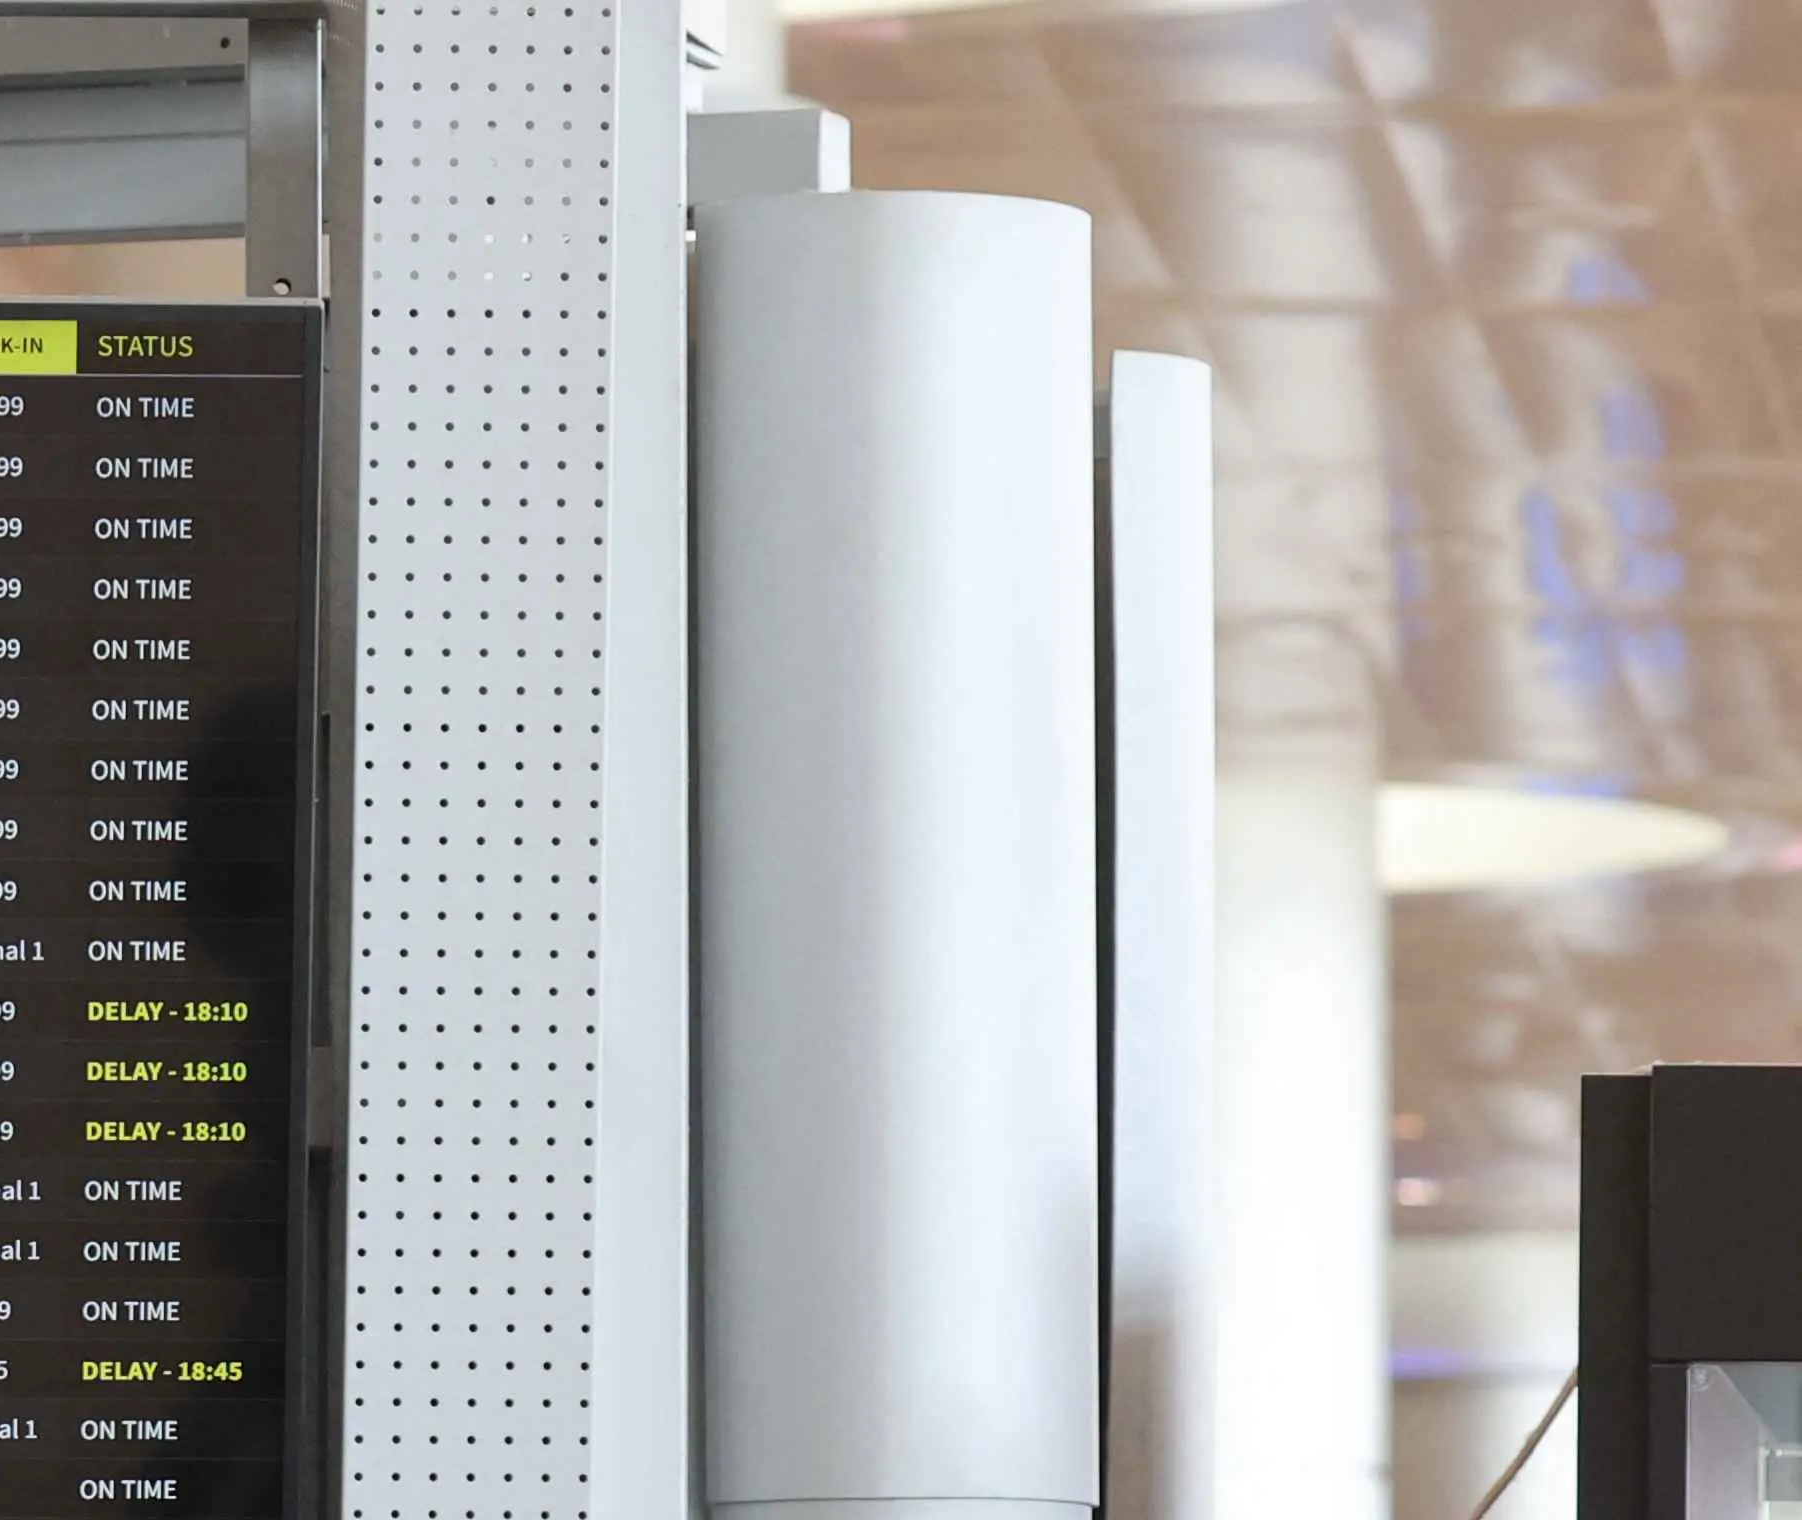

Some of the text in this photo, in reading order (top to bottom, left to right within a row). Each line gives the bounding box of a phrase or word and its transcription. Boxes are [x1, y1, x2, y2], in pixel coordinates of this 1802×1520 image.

[98, 335, 193, 357] STATUS
[96, 396, 131, 418] ON
[138, 397, 195, 418] TIME
[94, 518, 129, 540] ON
[136, 518, 193, 539] TIME
[91, 759, 126, 781] ON
[132, 760, 189, 781] TIME
[32, 941, 45, 961] 1
[88, 940, 123, 962] ON
[129, 940, 186, 961] TIME
[87, 1061, 163, 1081] DELAY
[182, 1062, 247, 1082] 18:10
[27, 1241, 40, 1260] 1
[83, 1241, 118, 1262] ON
[124, 1241, 181, 1262] TIME
[79, 1479, 115, 1500] ON
[120, 1479, 177, 1500] TIME
